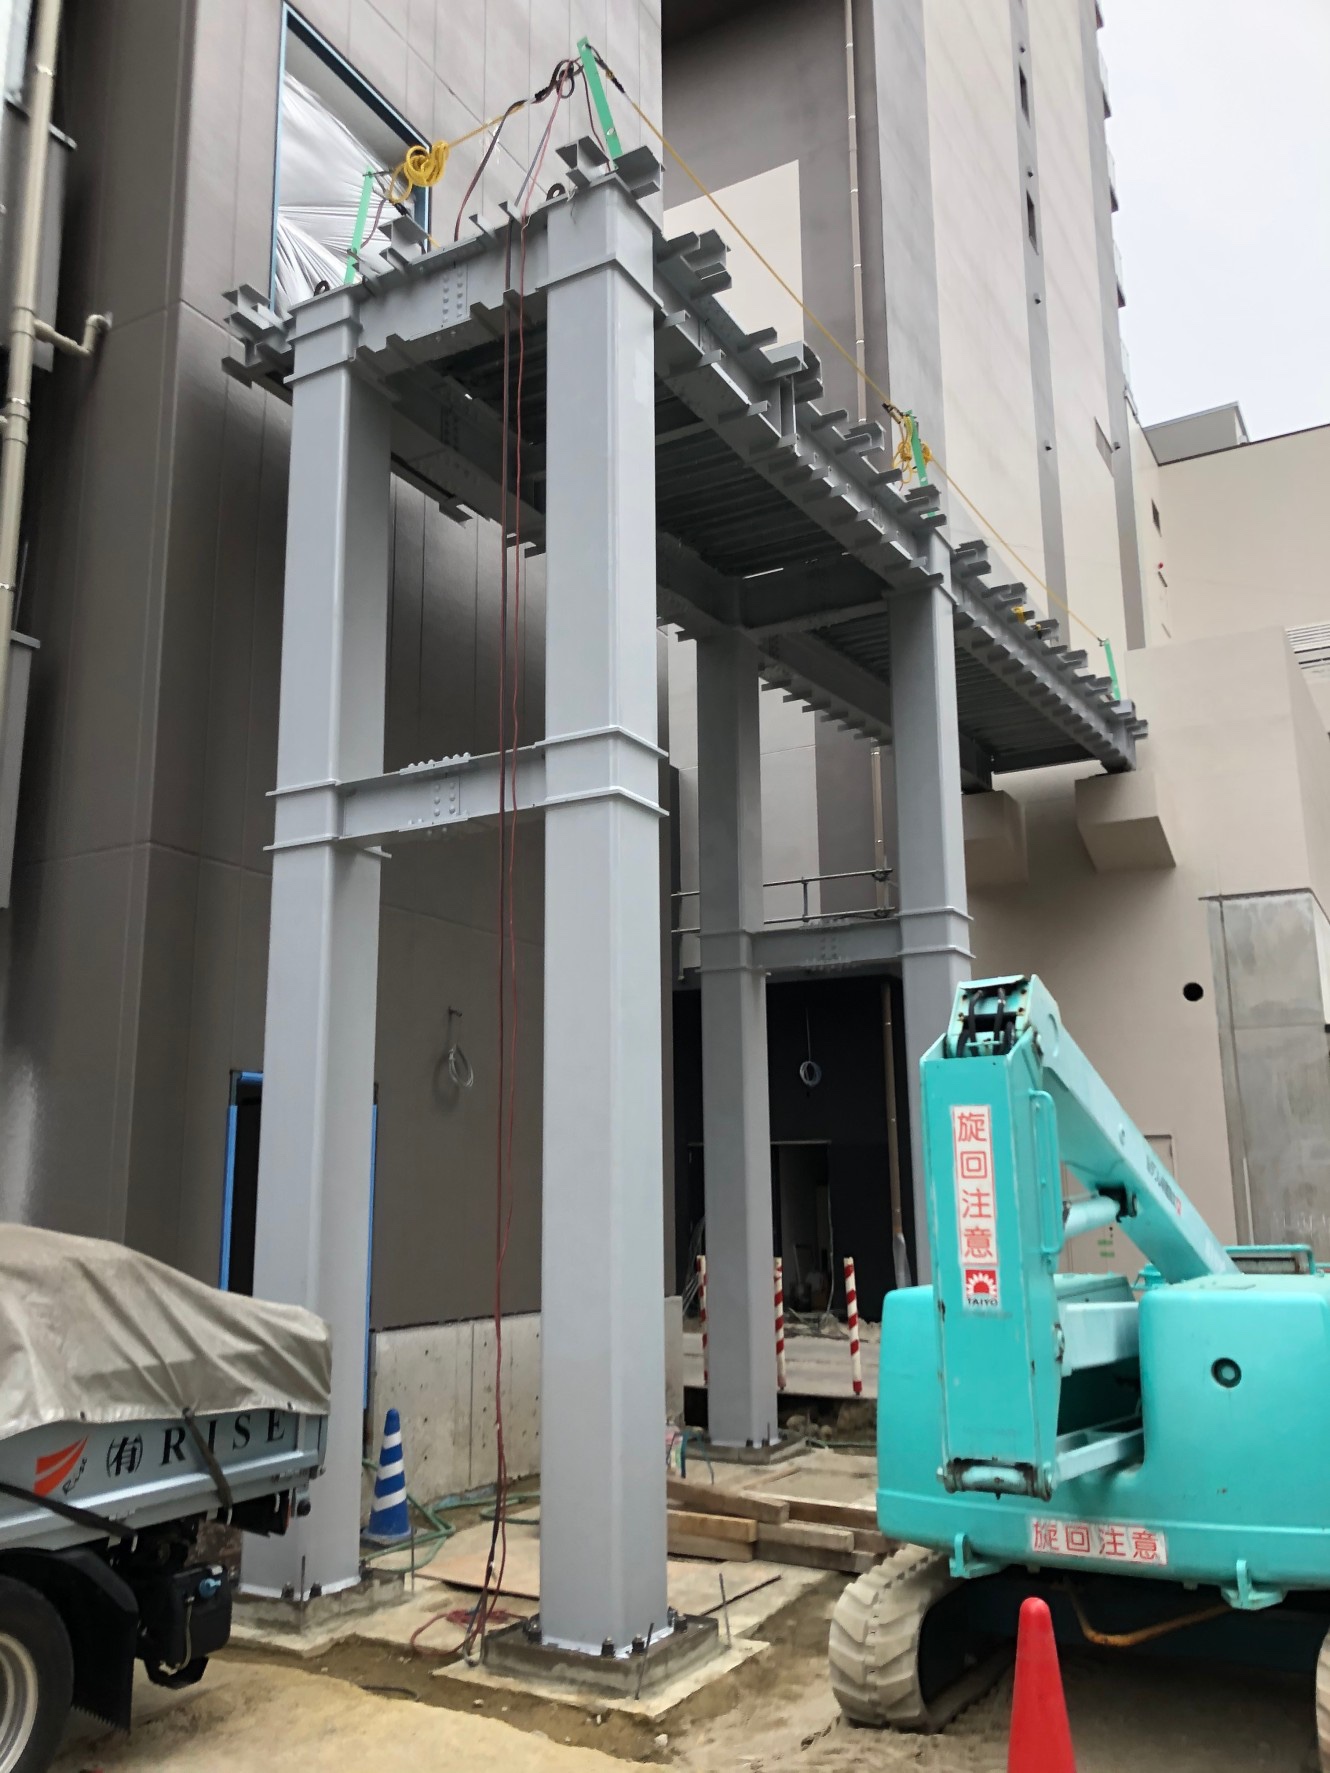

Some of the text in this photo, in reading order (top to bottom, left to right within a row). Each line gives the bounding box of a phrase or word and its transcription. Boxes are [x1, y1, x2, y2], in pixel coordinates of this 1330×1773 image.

[957, 1111, 993, 1259] 旋回注意
[967, 1298, 998, 1306] TAIYO
[161, 1409, 286, 1466] RISE
[1034, 1521, 1158, 1560] 旋回注意
